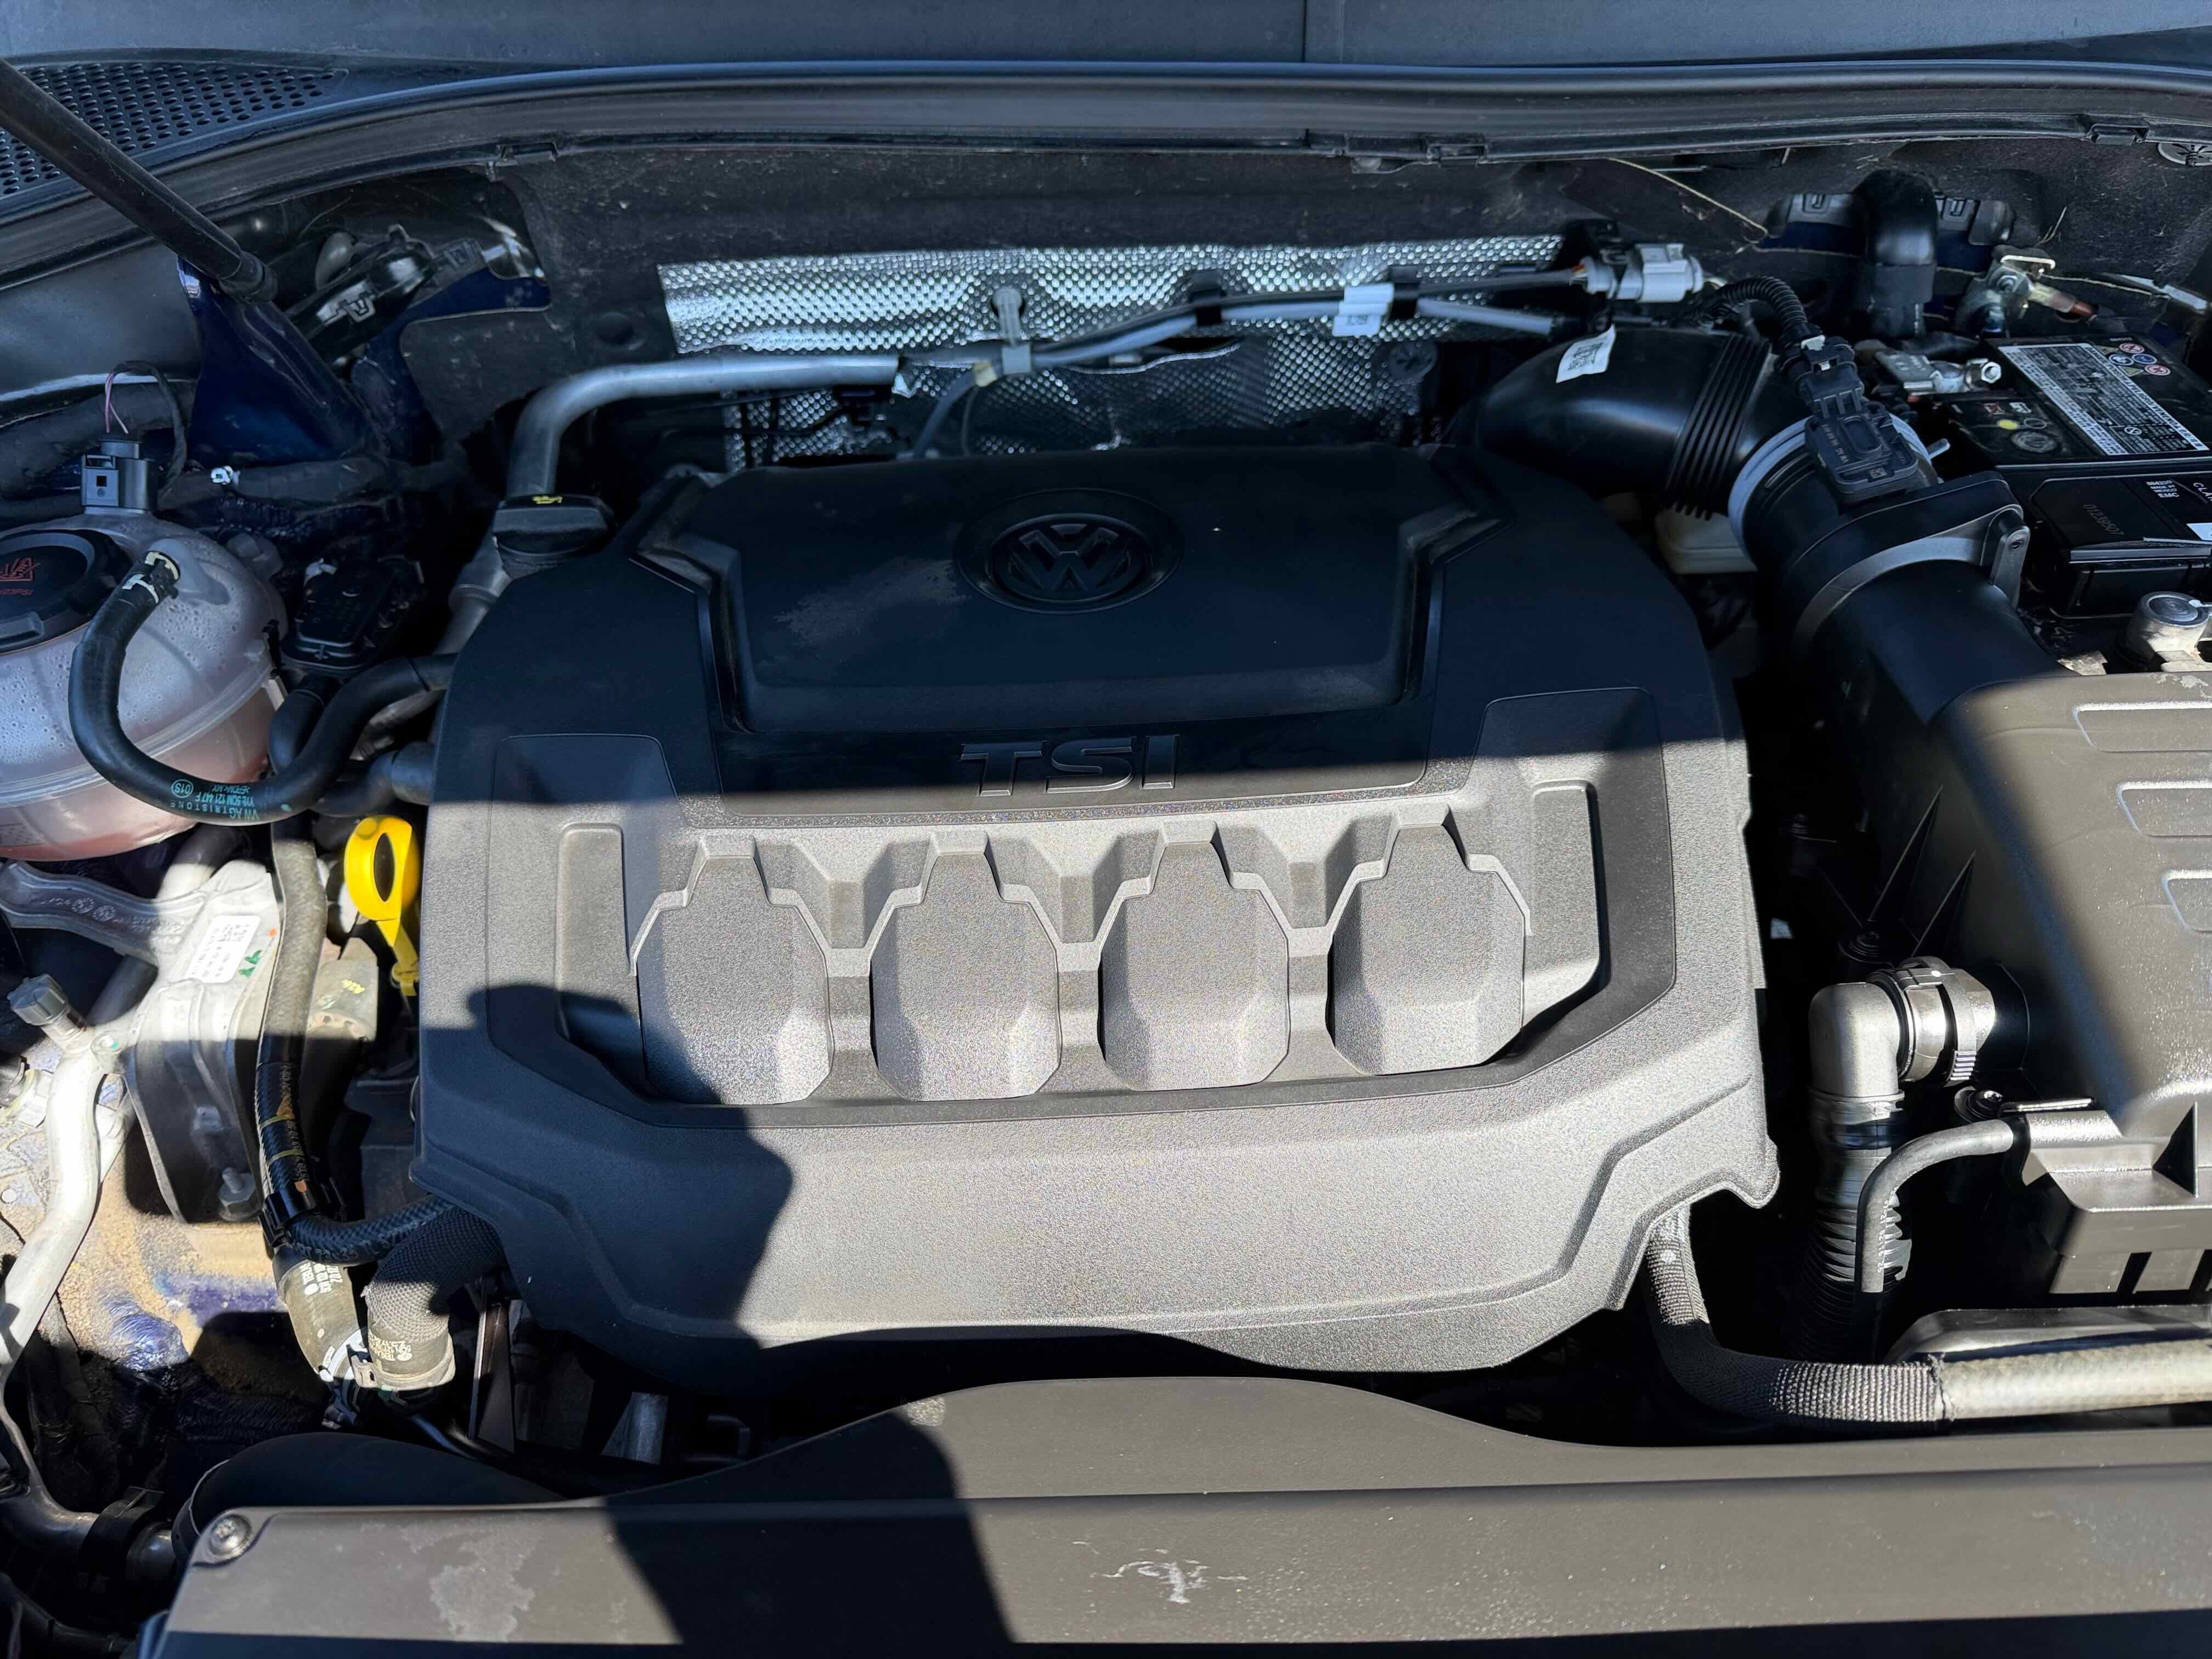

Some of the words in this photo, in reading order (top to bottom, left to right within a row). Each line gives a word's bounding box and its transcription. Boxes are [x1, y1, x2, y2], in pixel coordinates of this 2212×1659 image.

[958, 733, 1180, 798] TSI
[174, 782, 191, 794] 01S
[195, 791, 201, 802] F
[229, 807, 243, 820] AG
[245, 808, 259, 821] VW
